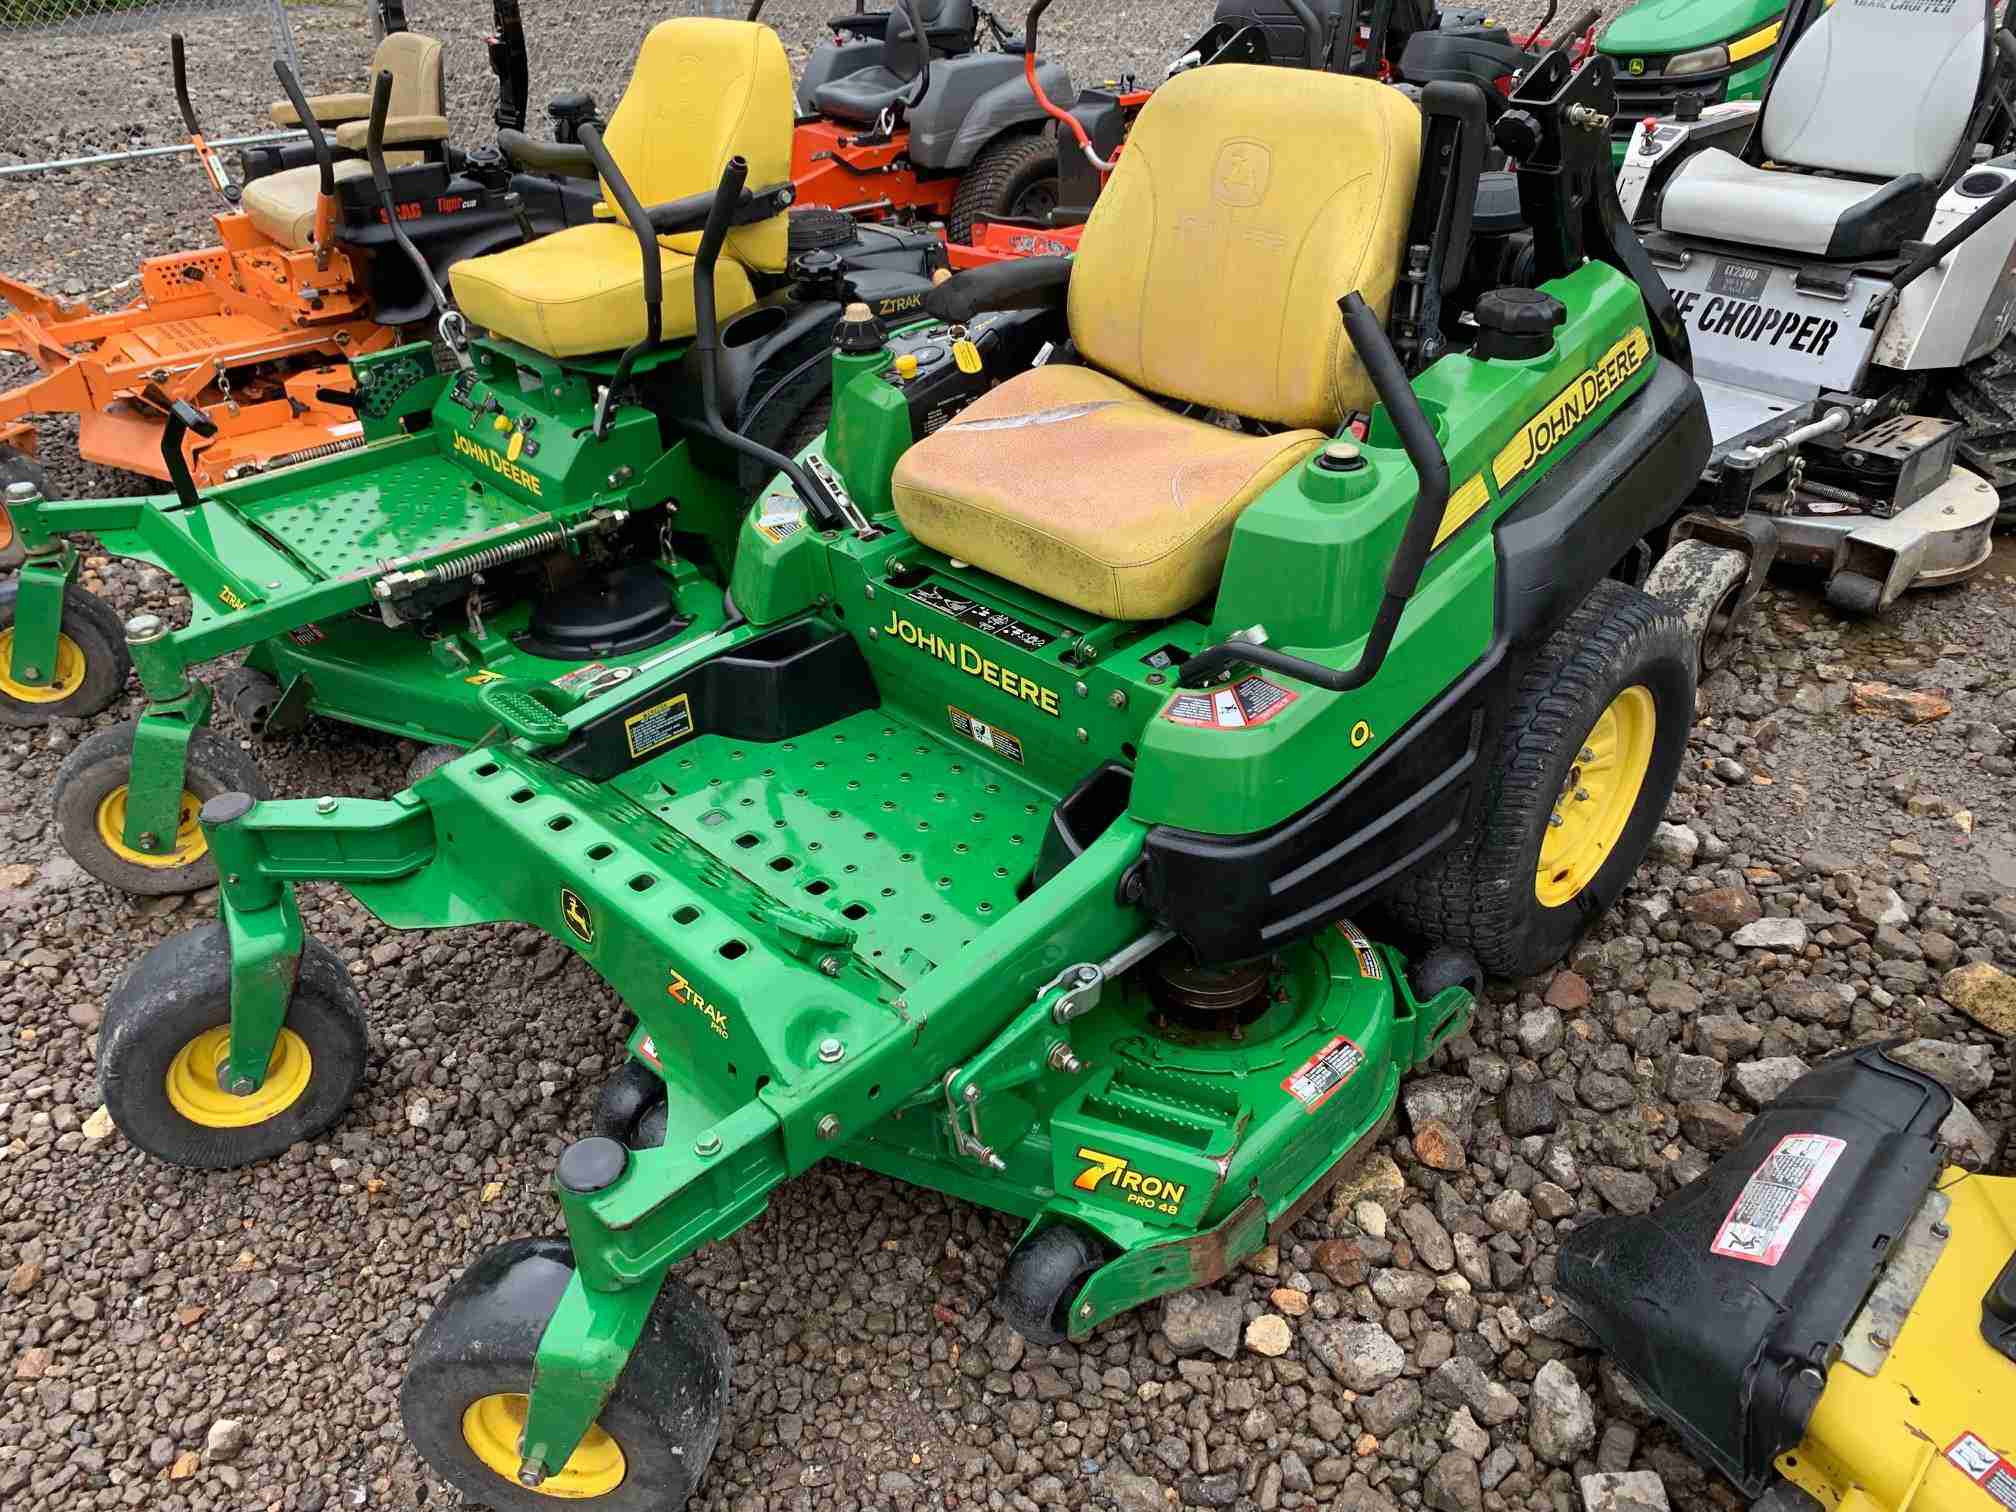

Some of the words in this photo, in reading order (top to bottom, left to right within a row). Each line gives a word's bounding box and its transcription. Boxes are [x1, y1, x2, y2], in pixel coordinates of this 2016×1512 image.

[879, 293, 921, 315] ZTRAK
[1698, 296, 1839, 357] CHOPPER
[1523, 394, 1580, 467] JOHN
[1580, 340, 1642, 409] DEERE
[453, 428, 490, 467] JOHN
[490, 449, 543, 497] DEERE
[883, 609, 957, 666] JOHN
[959, 643, 1060, 717] DEERE
[667, 968, 727, 1030] ZTRAK
[711, 1022, 729, 1040] PRO
[1127, 1193, 1156, 1209] PRO
[1158, 1202, 1179, 1216] 48
